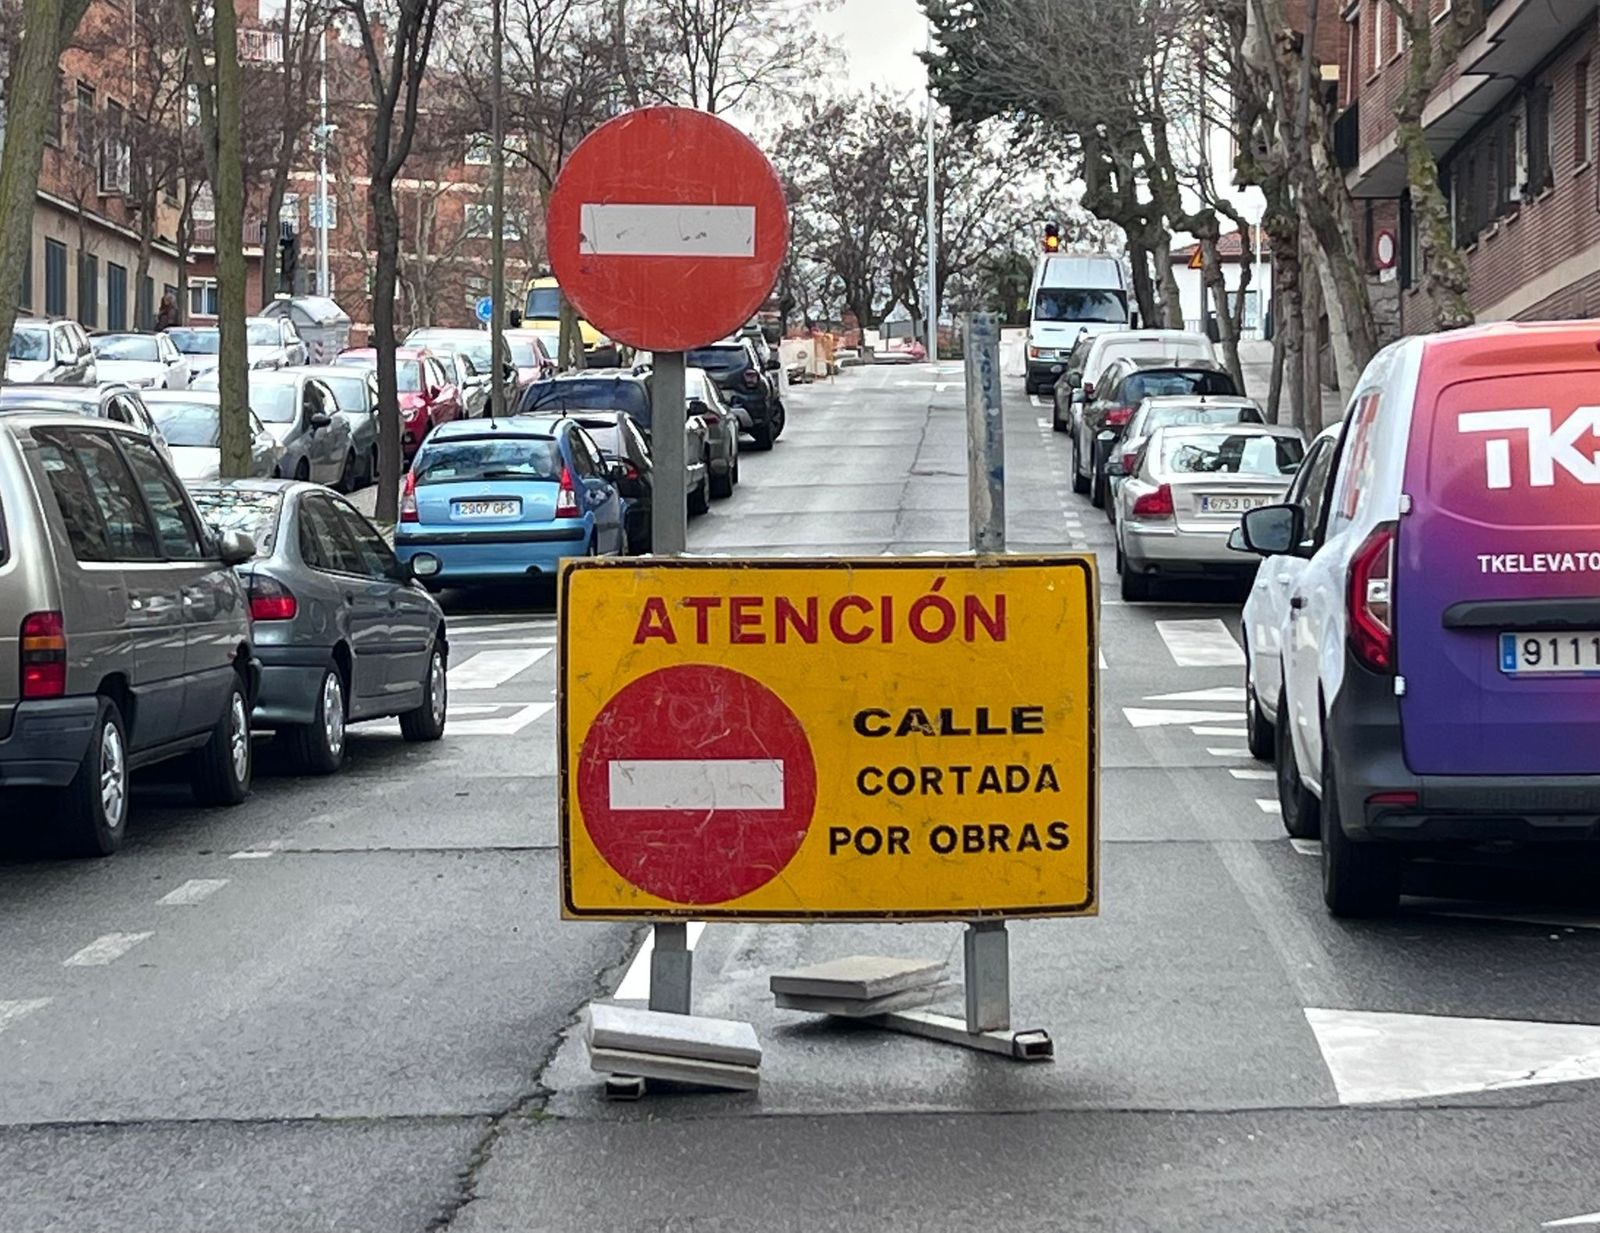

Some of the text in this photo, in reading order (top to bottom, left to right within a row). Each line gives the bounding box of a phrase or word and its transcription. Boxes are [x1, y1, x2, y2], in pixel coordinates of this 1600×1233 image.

[1458, 405, 1600, 490] TK
[461, 501, 515, 515] 2907 GPS
[632, 577, 1007, 644] ATENCIÓN
[1524, 637, 1600, 666] 9111
[853, 706, 1045, 737] CALLE
[856, 764, 1061, 796] CORTADA
[829, 821, 1070, 857] POR OBRAS
